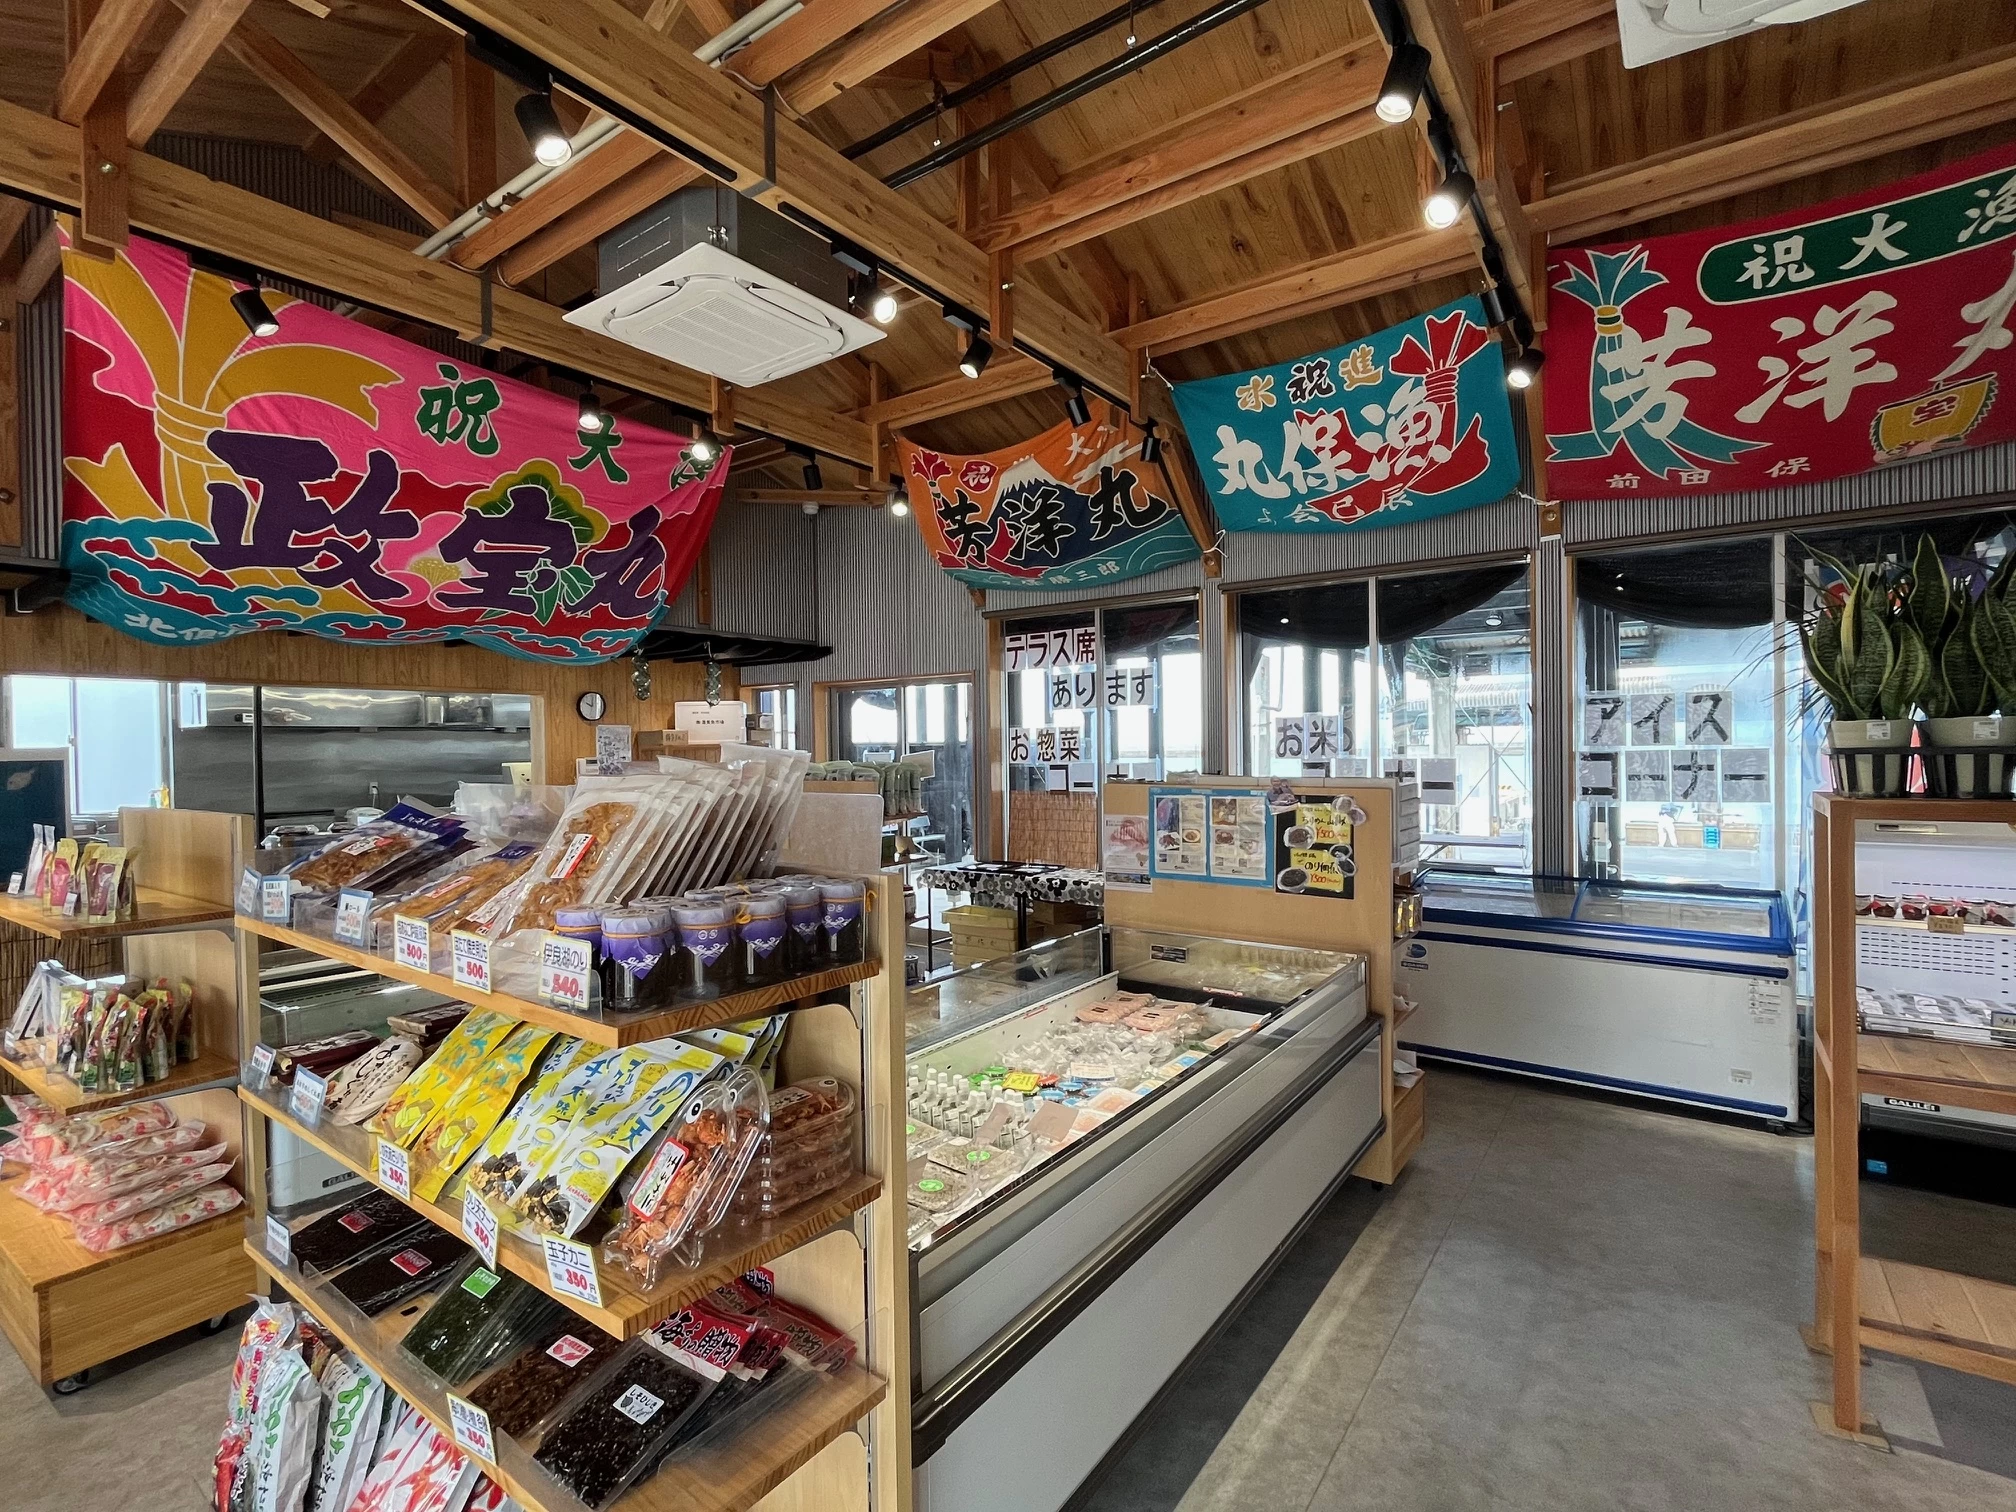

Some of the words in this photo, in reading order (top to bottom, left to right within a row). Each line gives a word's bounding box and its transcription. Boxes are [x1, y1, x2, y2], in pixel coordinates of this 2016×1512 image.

[1007, 629, 1095, 669] テラス席
[1052, 669, 1153, 707] あります
[1587, 694, 1728, 743] アイス
[1011, 728, 1080, 761] お惣菜
[1581, 752, 1765, 799] コーナー
[546, 1240, 590, 1268] 玉子カニ
